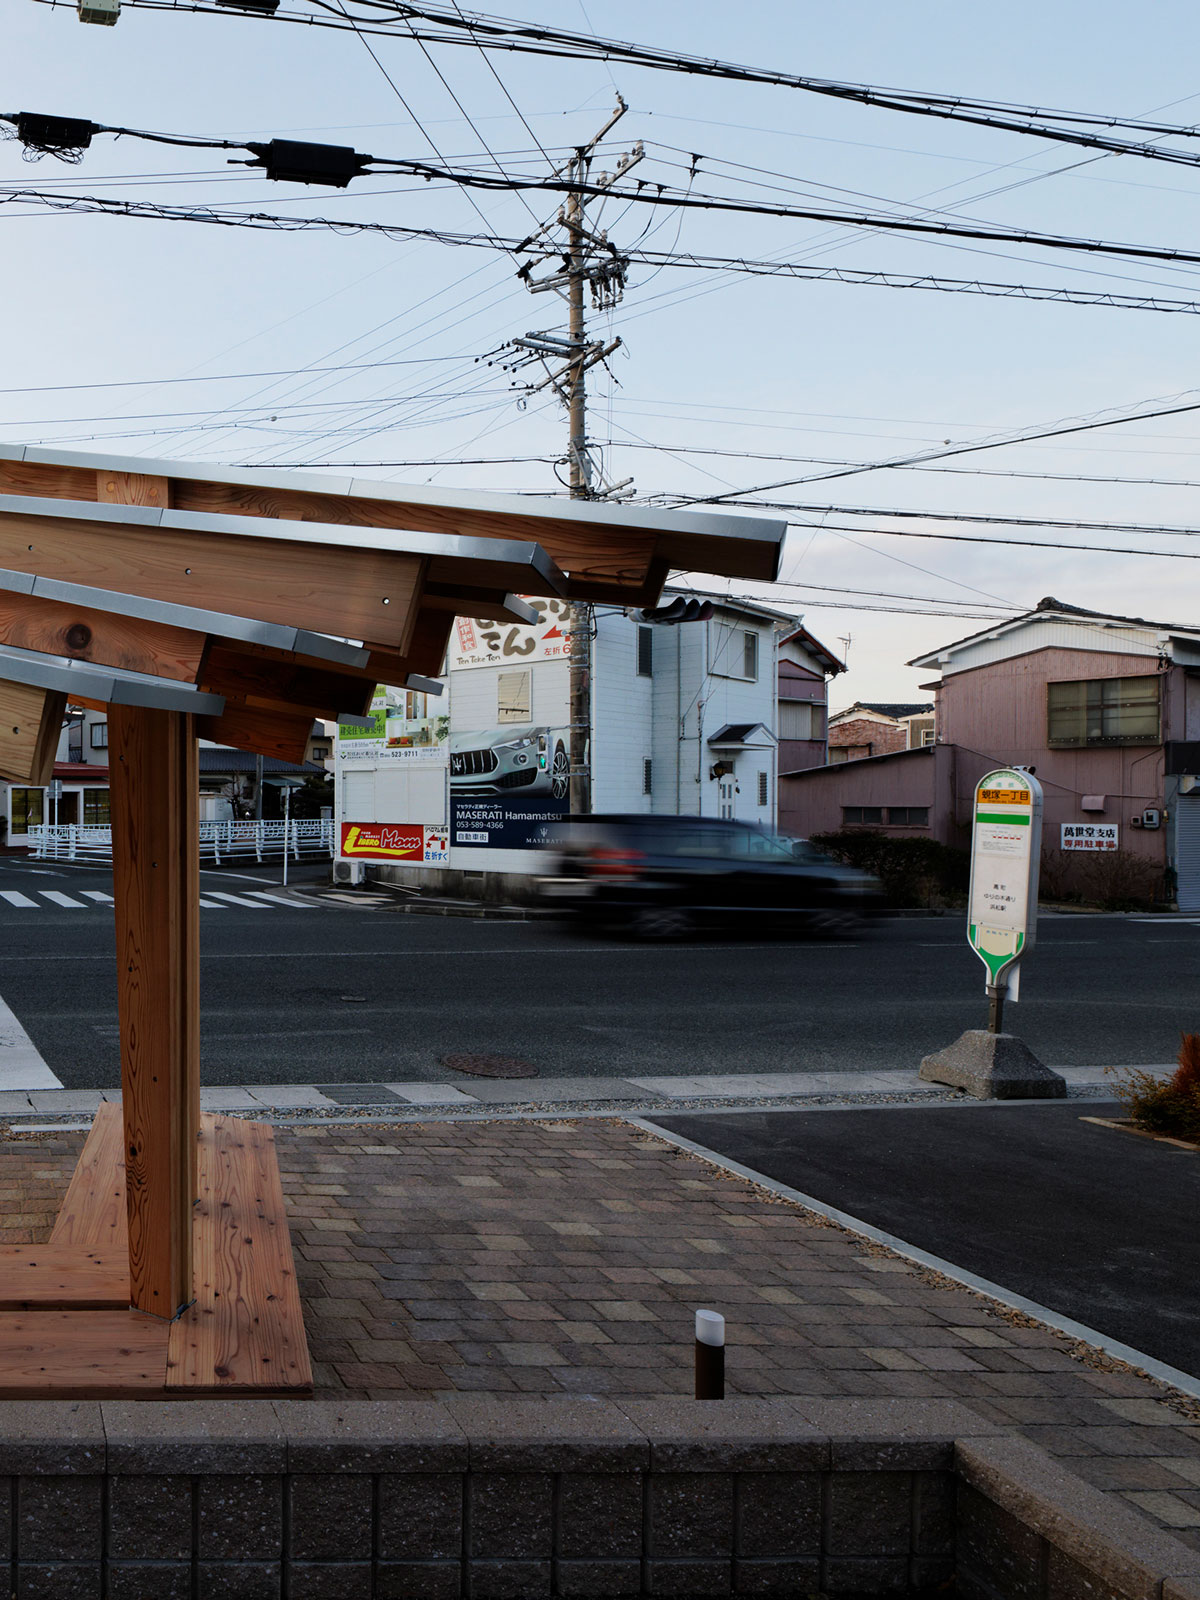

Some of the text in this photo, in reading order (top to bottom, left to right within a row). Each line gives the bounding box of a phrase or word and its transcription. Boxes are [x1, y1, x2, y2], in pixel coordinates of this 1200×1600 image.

[544, 646, 560, 656] 左折
[456, 657, 469, 665] Ten
[486, 653, 501, 662] Ten
[456, 811, 562, 821] MASERATI Hamamatsu
[456, 821, 504, 829] 053-589-4366
[1064, 826, 1116, 838] 萬世堂支店
[381, 828, 422, 849] Mom
[1064, 839, 1116, 849] 専用駐車場
